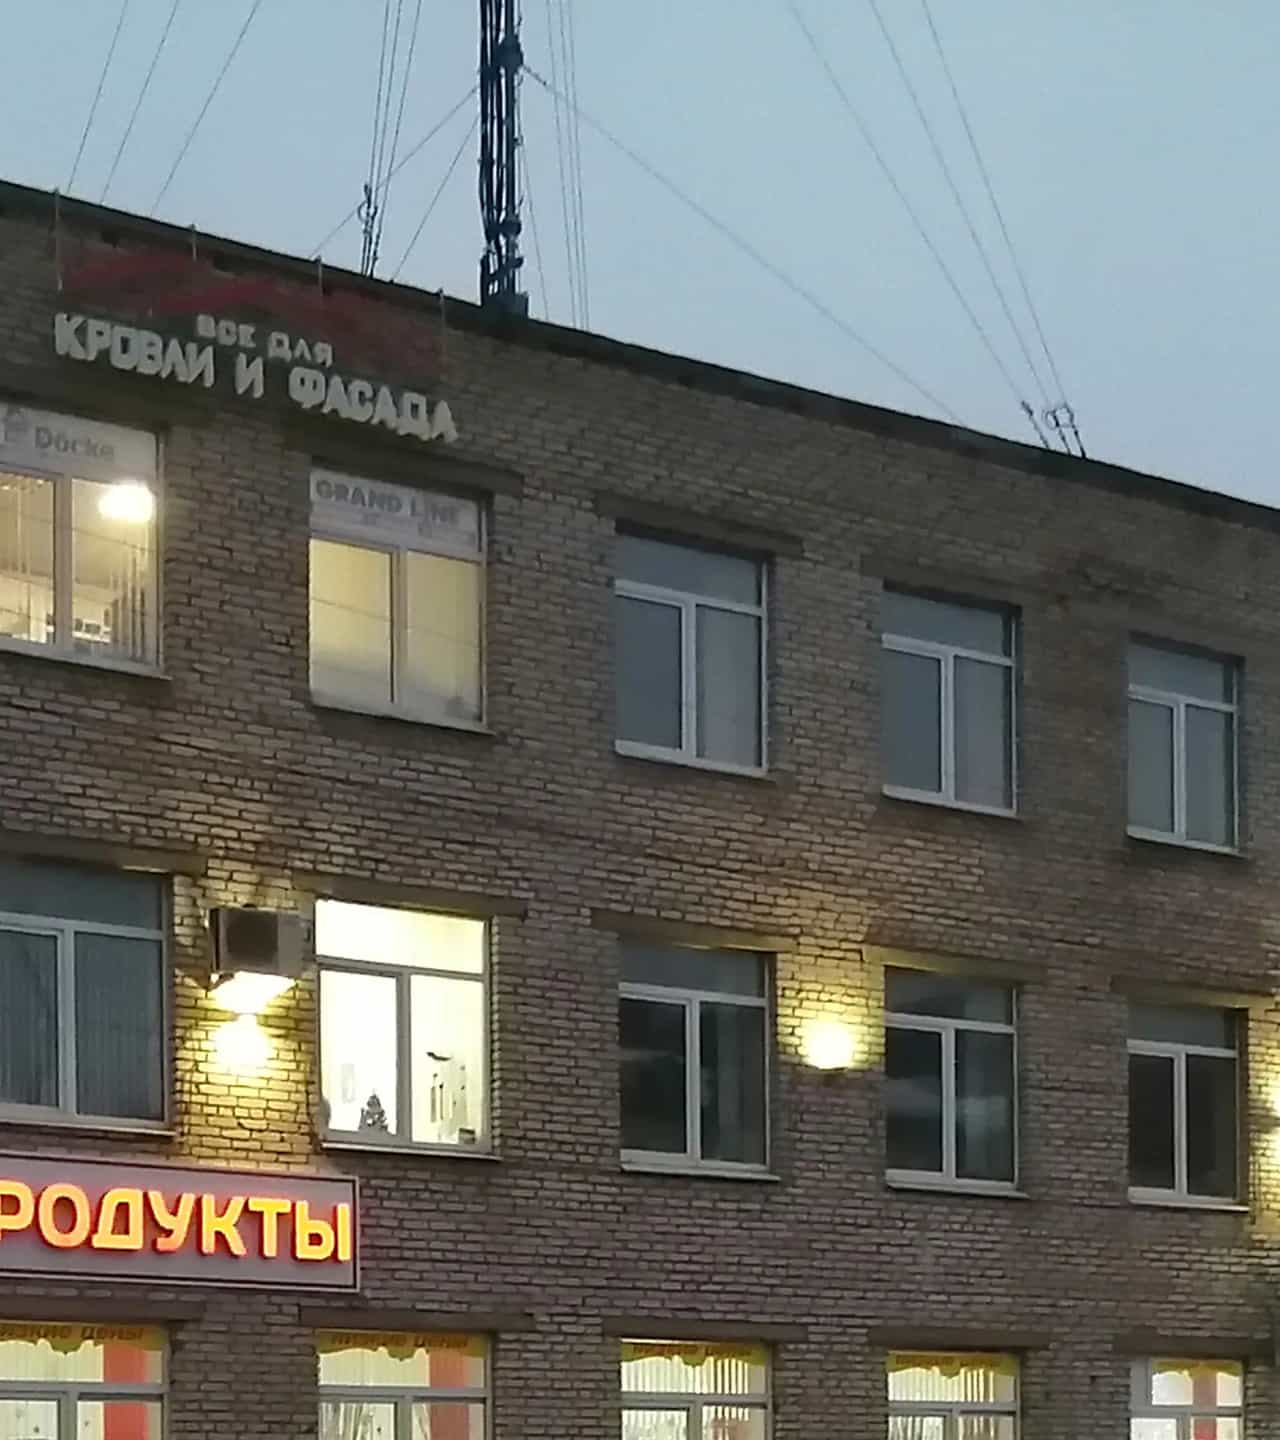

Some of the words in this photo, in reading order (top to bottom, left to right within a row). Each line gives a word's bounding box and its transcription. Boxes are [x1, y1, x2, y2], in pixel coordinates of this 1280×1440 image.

[53, 312, 215, 388] КРОВЛИ
[235, 352, 265, 399] И
[288, 366, 459, 443] ФАСАДА
[267, 331, 333, 367] ДЛЯ
